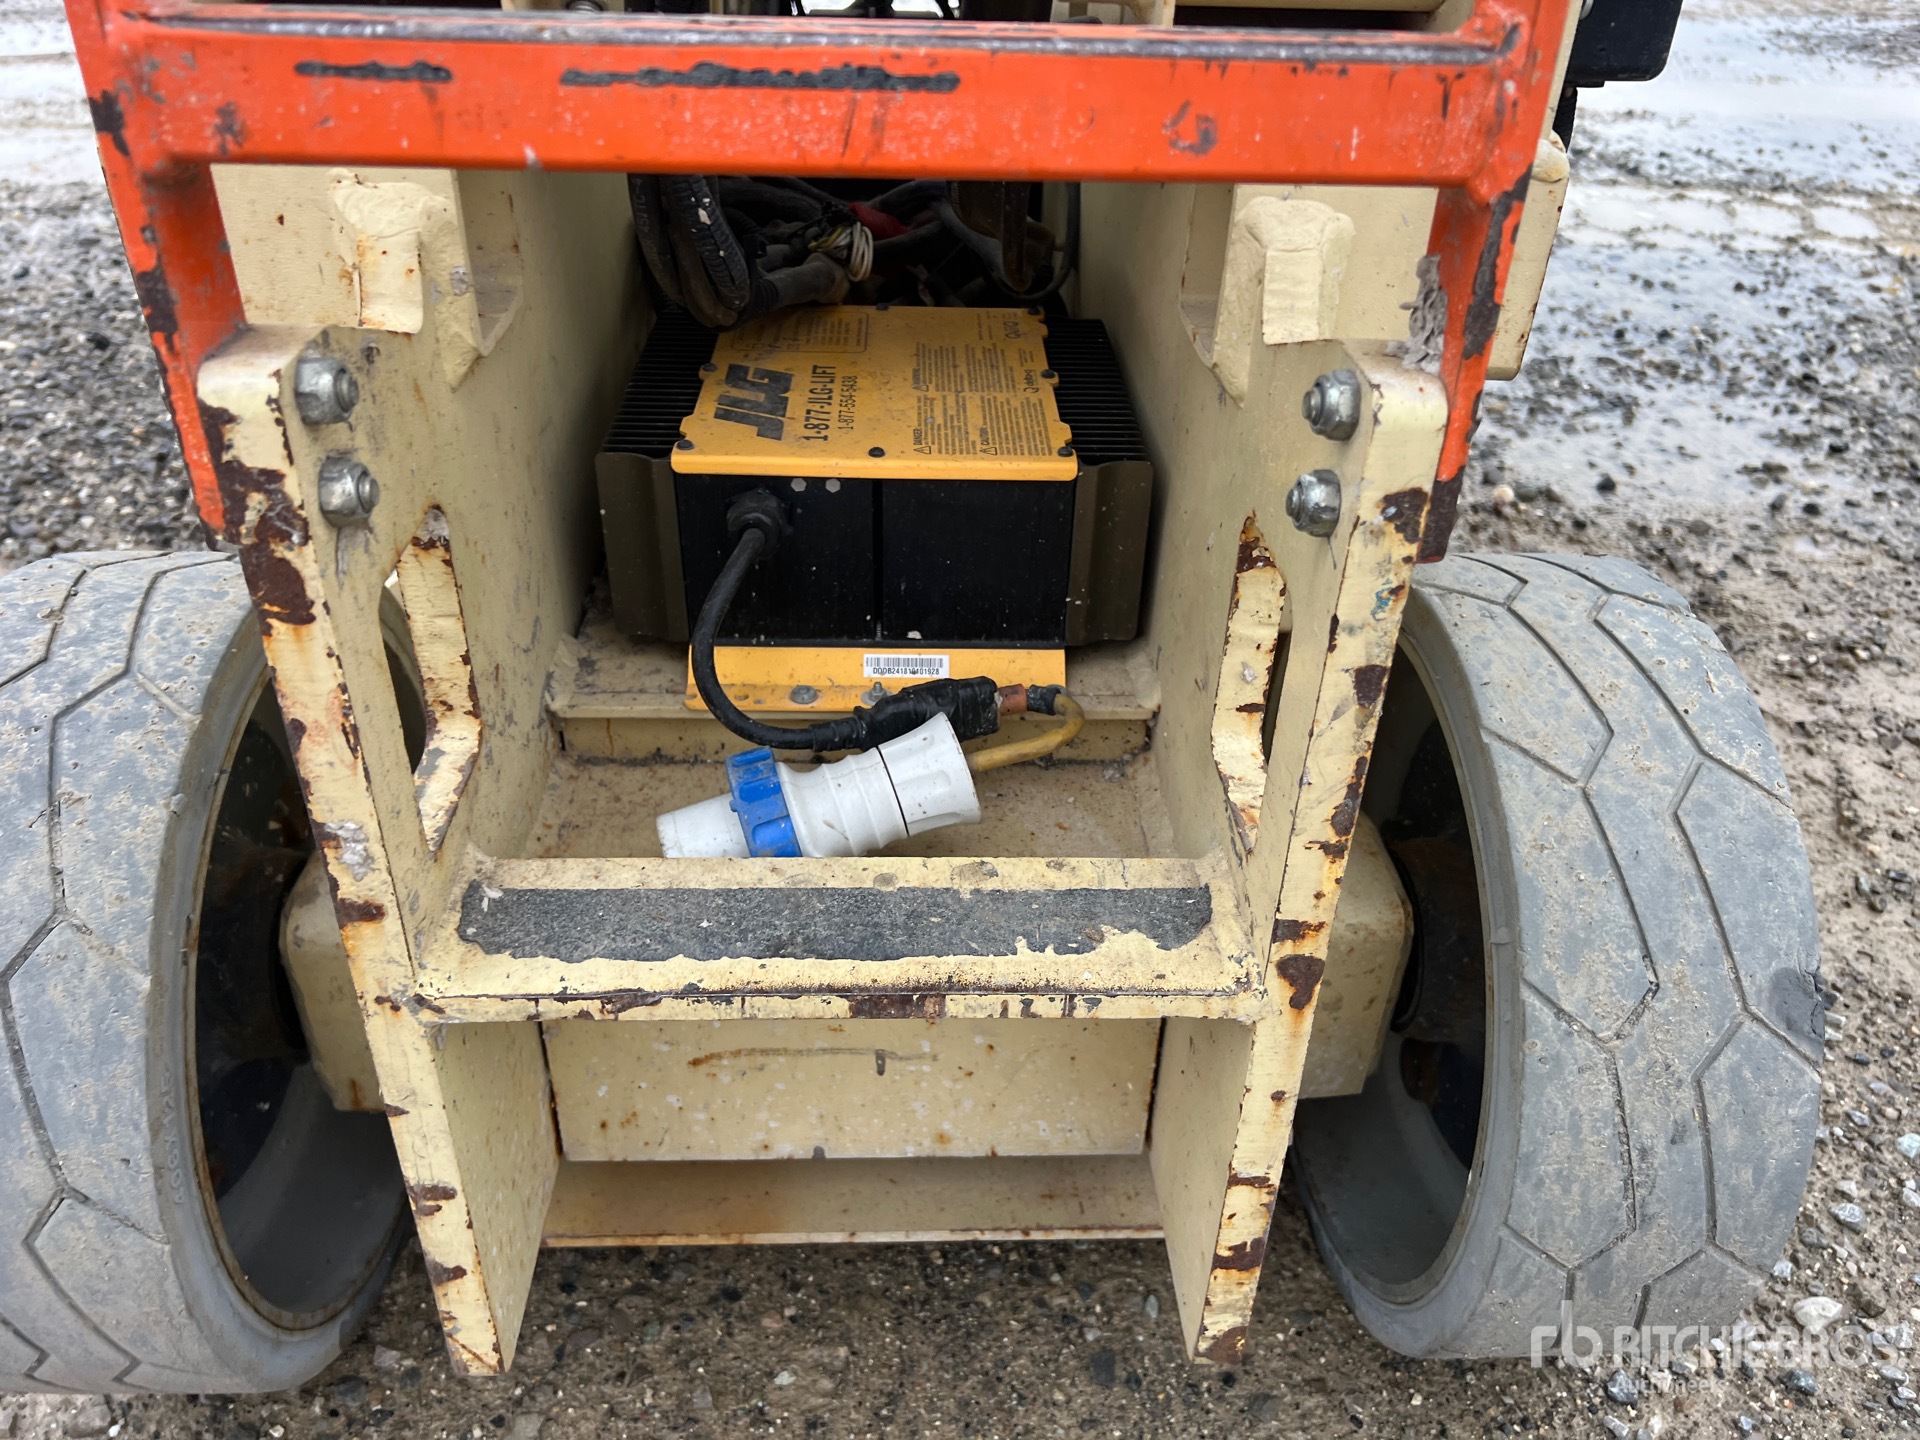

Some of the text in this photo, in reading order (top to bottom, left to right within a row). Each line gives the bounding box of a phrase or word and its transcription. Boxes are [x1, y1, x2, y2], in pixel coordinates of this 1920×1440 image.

[713, 363, 794, 441] JLG
[801, 364, 836, 441] 1-877-JLG-LIFT
[837, 375, 858, 430] 1-877-554-5438
